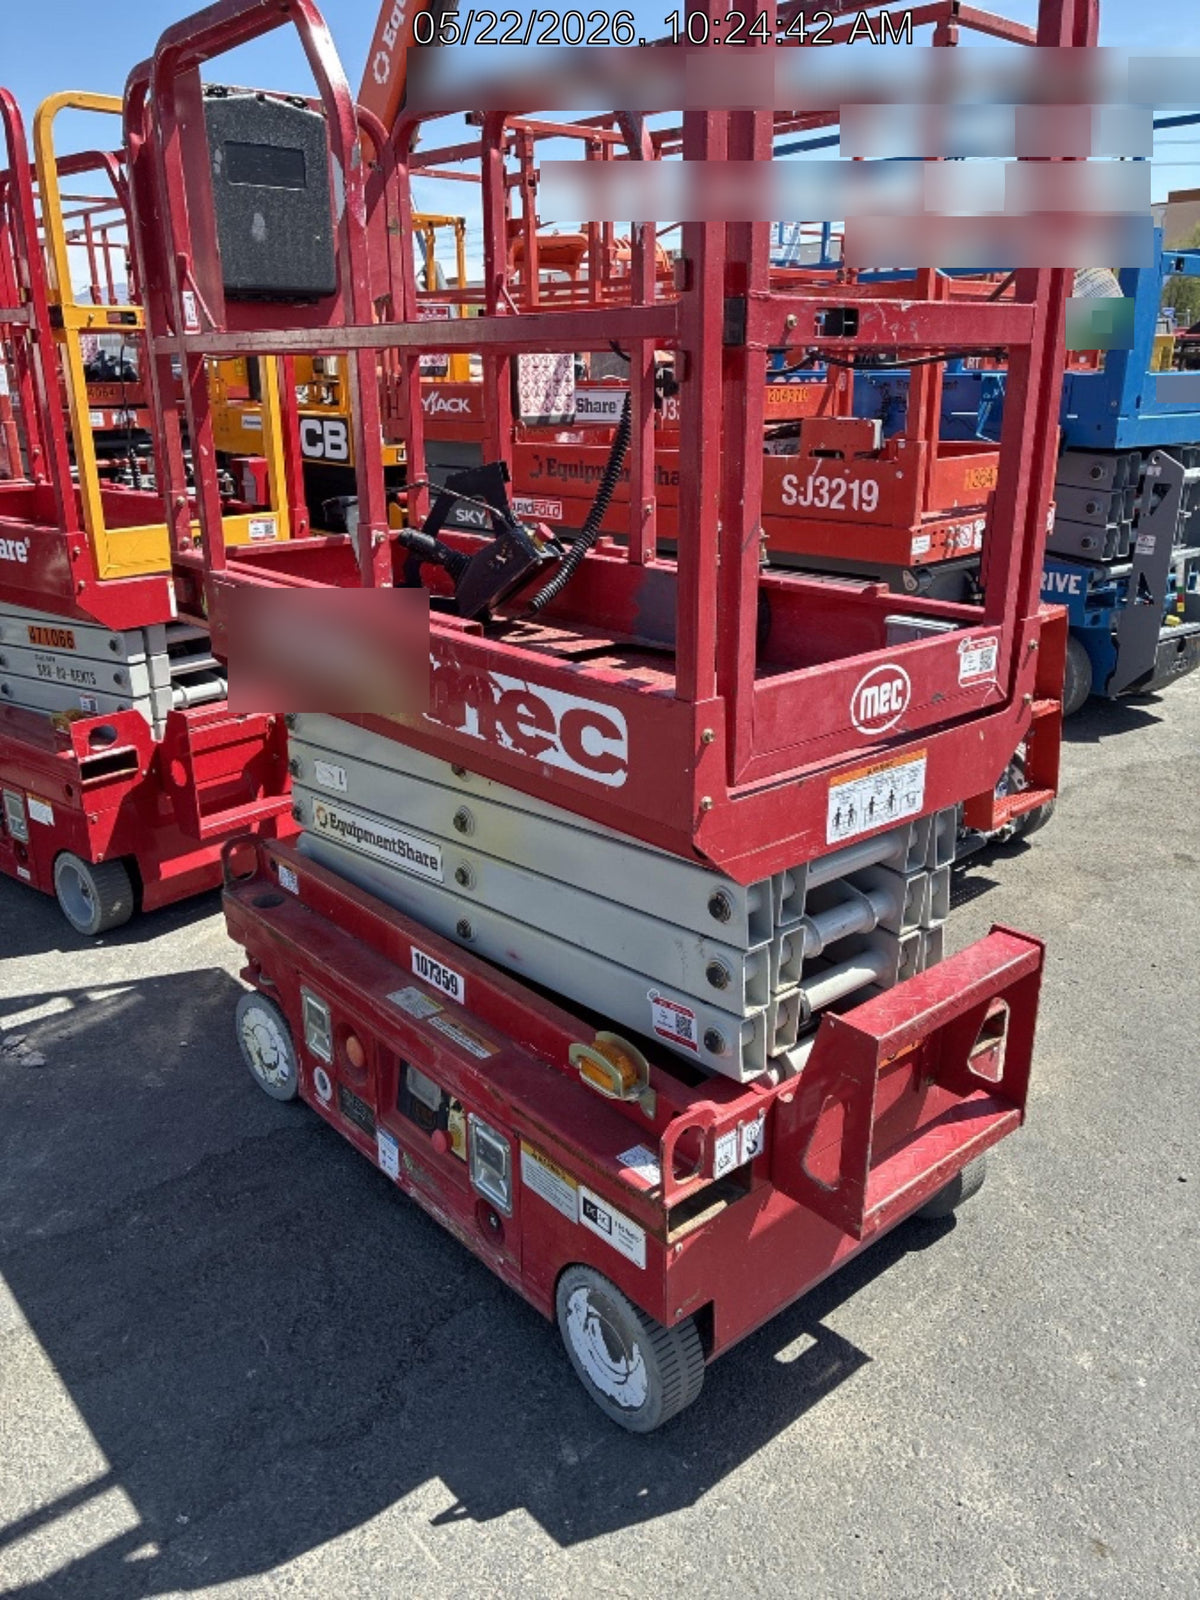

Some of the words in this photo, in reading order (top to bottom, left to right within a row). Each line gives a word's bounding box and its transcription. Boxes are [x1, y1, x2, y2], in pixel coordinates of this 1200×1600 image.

[300, 418, 348, 460] CB
[781, 473, 880, 513] SJ3219
[455, 508, 486, 524] SKY
[329, 810, 439, 872] EquipmentShare
[413, 950, 460, 997] 107359
